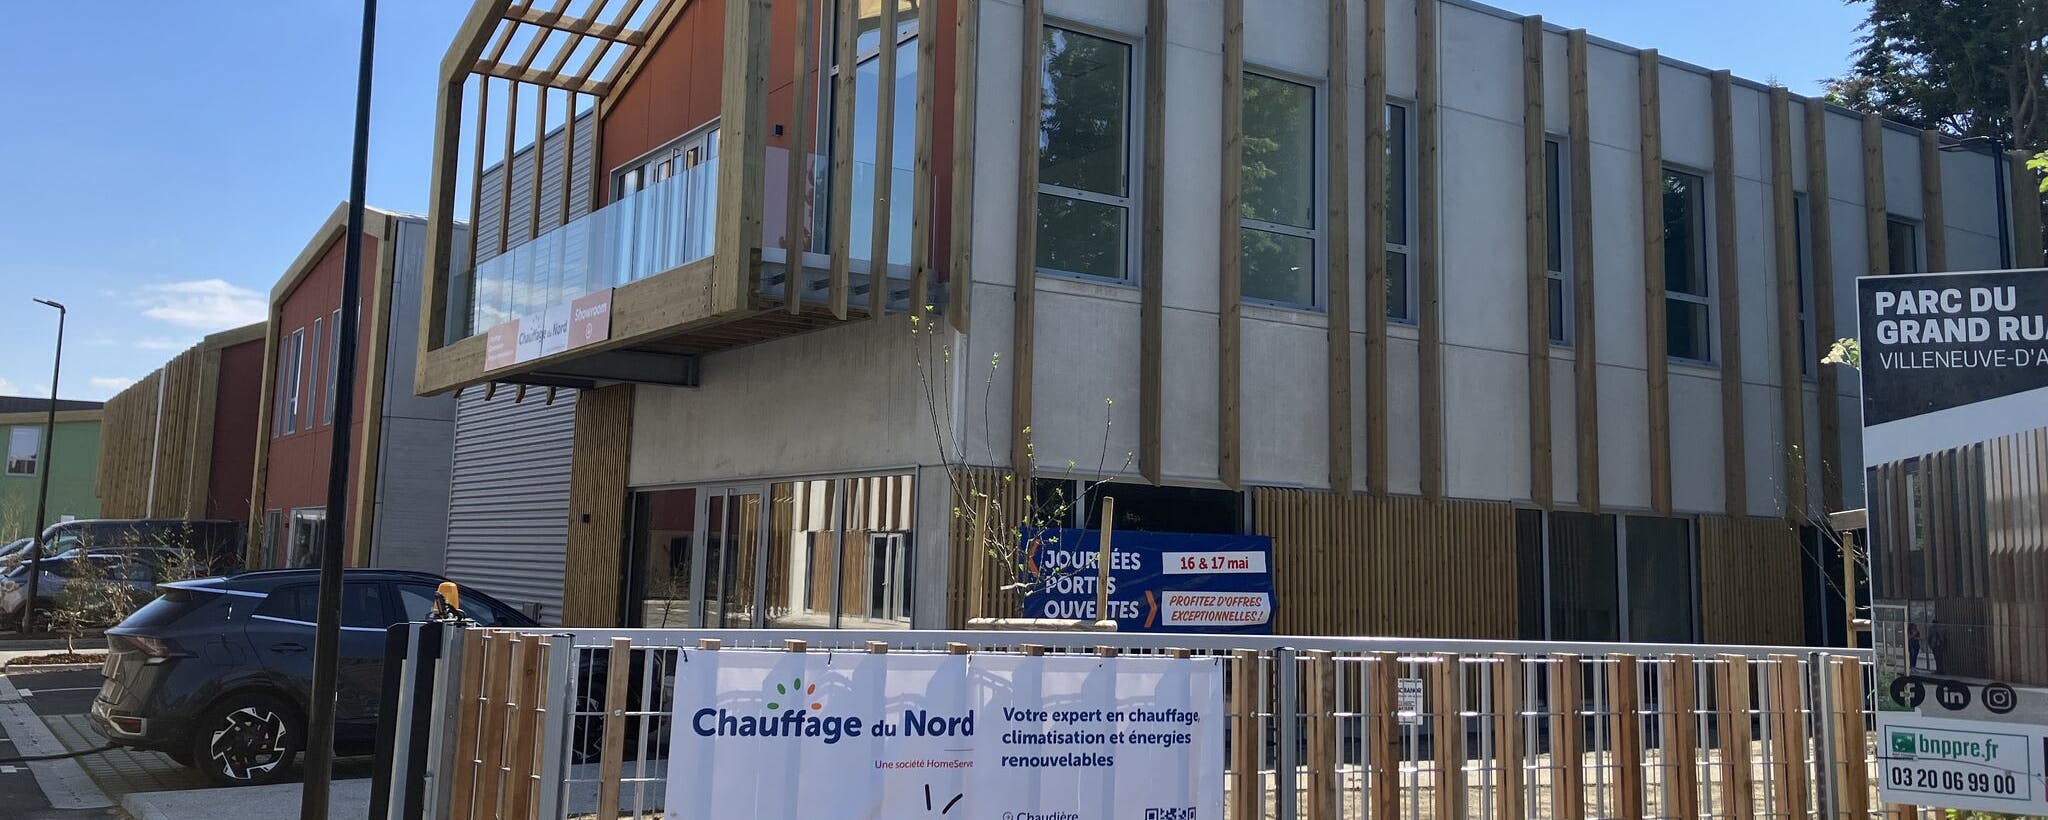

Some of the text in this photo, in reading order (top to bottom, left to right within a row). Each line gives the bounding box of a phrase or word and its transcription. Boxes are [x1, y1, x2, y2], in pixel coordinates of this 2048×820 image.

[1875, 286, 2017, 316] PARC DU
[575, 302, 607, 321] Showroom
[1876, 315, 2048, 345] GRAND RU
[1044, 548, 1141, 570] JOURÉES
[1180, 556, 1249, 570] 16 & 17 mai
[1045, 576, 1117, 595] PORTS
[1044, 599, 1139, 619] OUVETES
[1169, 596, 1262, 607] PROFITEZ D'OFFRES
[692, 707, 974, 745] Chauffage du Nord
[1003, 707, 1048, 722] Votre
[1052, 708, 1102, 726] expert
[1106, 710, 1125, 722] en
[1002, 730, 1192, 747] climatisation et énergies
[1919, 734, 1999, 762] bnppre.fr
[875, 760, 894, 769] Une
[895, 759, 925, 769] société
[1001, 753, 1114, 767] renouvelables
[1892, 766, 2015, 795] 03 20 06 99 00
